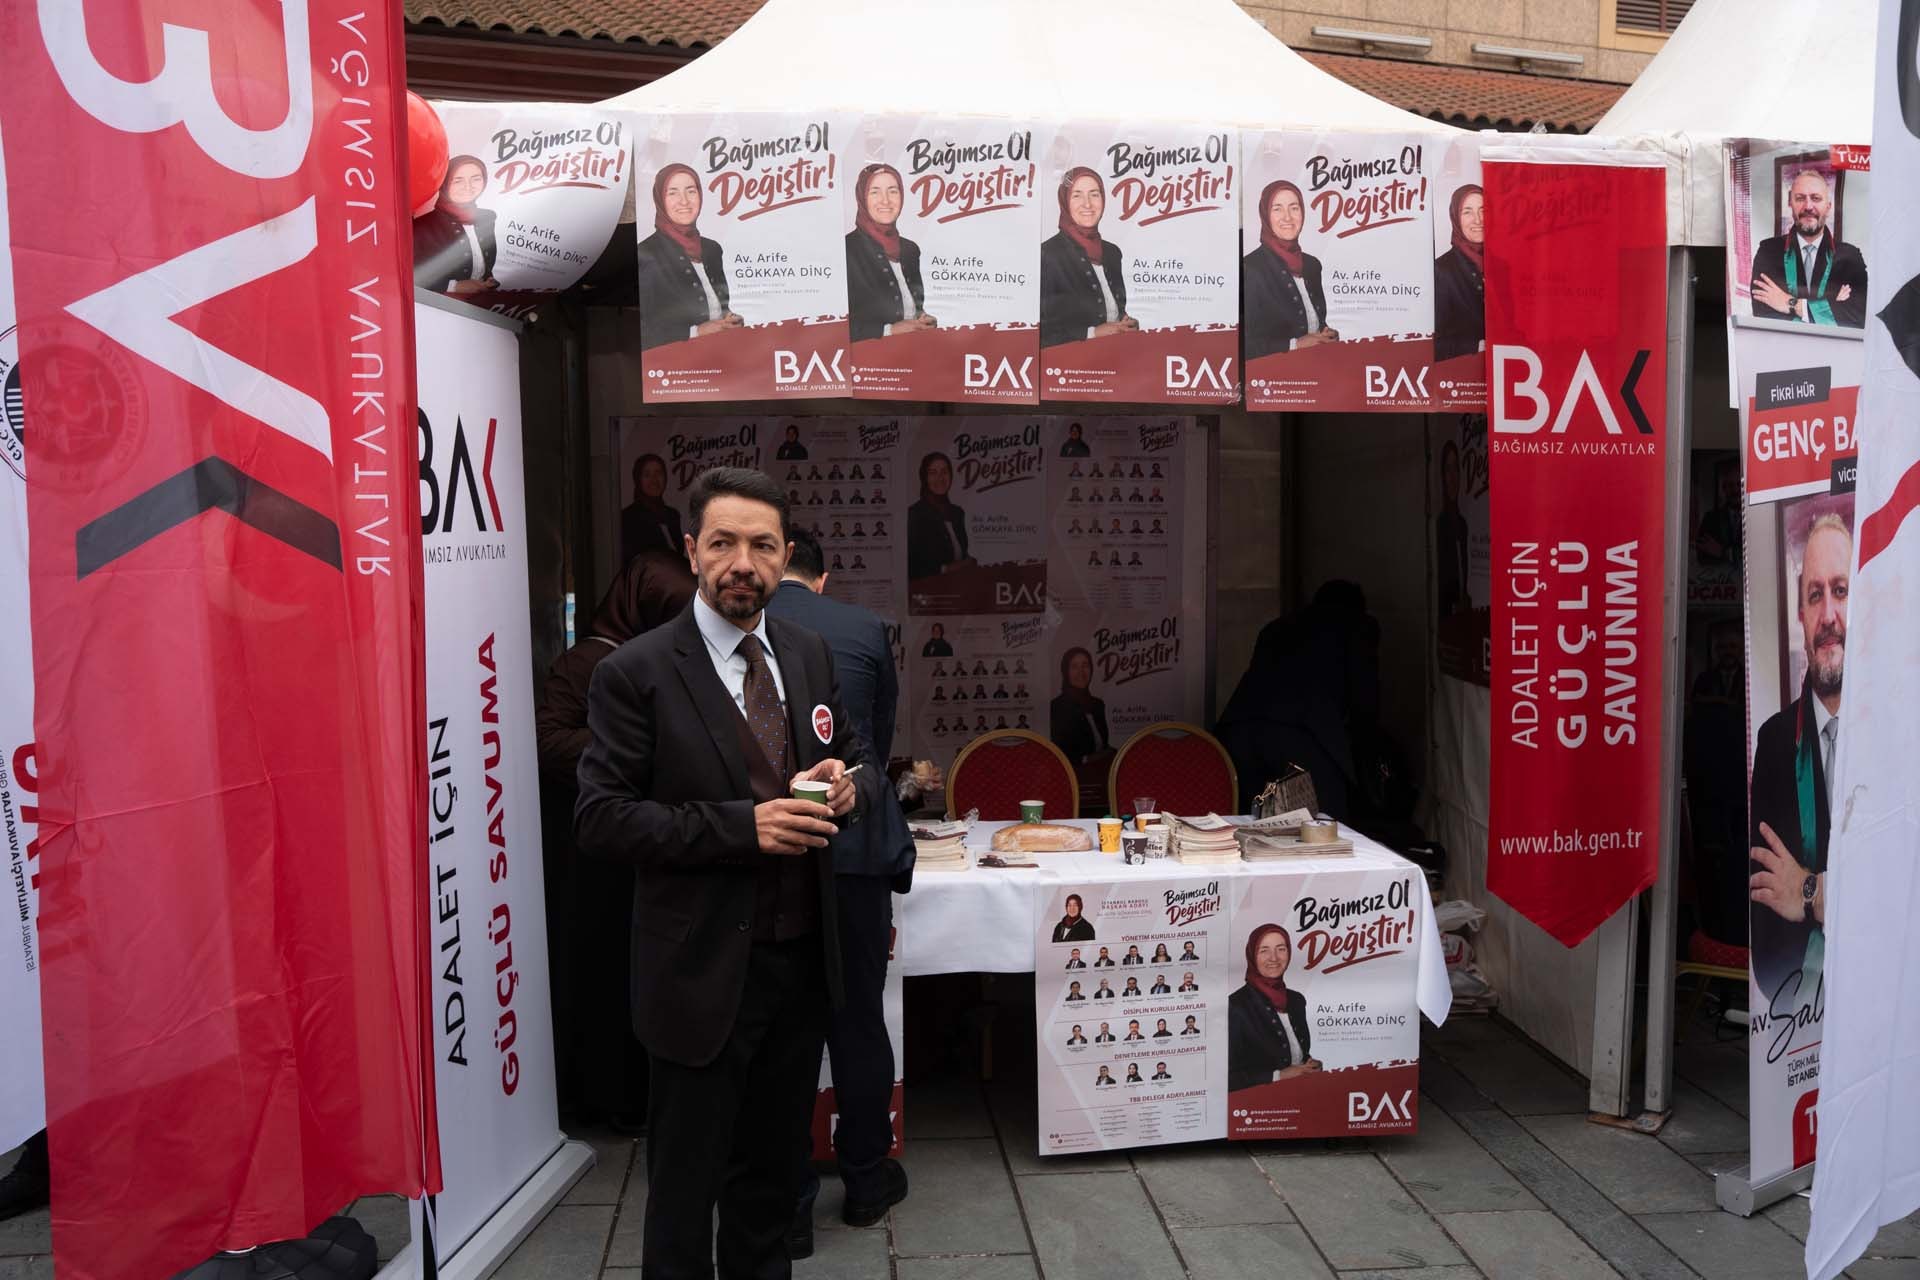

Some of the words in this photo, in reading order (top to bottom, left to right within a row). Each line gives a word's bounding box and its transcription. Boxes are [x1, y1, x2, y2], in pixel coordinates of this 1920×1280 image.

[491, 128, 593, 163] Bağımsız
[596, 120, 622, 147] Ol
[702, 136, 801, 173] Bağımsız
[804, 121, 829, 152] Ol
[906, 139, 1004, 175] Bağımsız
[1007, 131, 1032, 161] Ol
[1107, 142, 1202, 178] Bağımsız
[1205, 134, 1228, 163] Ol
[494, 147, 626, 192] Değiştir!
[708, 153, 836, 216] Değiştir!
[1305, 155, 1397, 191] Bağımsız
[1400, 144, 1422, 175] Ol
[910, 163, 1036, 218] Değiştir!
[1112, 165, 1233, 221] Değiştir!
[1311, 176, 1427, 233] Değiştir!
[506, 234, 561, 259] GÖKKAYA
[508, 220, 526, 233] Av.
[530, 225, 560, 242] Arife
[734, 253, 753, 263] Av.
[757, 252, 788, 263] Arife
[735, 266, 796, 278] GÖKKAYA
[800, 265, 832, 279] DİNÇ
[931, 255, 949, 266] Av.
[953, 256, 984, 267] Arife
[1133, 258, 1150, 268] Av.
[1154, 259, 1184, 270] Arife
[1332, 270, 1349, 280] Av.
[1353, 270, 1381, 280] Arife
[931, 269, 990, 282] GÖKKAYA
[995, 272, 1025, 286] DİNÇ
[1133, 271, 1190, 284] GÖKKAYA
[1194, 273, 1225, 287] DİNÇ
[1332, 283, 1388, 295] GÖKKAYA
[1392, 283, 1421, 297] DİNÇ
[774, 349, 846, 384] BAK
[964, 353, 1034, 389] BAK
[1166, 355, 1233, 390] BAK
[1365, 365, 1430, 398] BAK
[1492, 344, 1655, 435] BAK
[1771, 383, 1794, 402] FİKRİ
[1796, 381, 1815, 398] HÜR
[667, 434, 737, 461] Bağımsız
[954, 433, 1021, 459] Bağımsız
[1023, 424, 1040, 446] Ol
[1493, 437, 1564, 455] BAĞIMSIZ
[1571, 441, 1656, 456] AVUKATLAR
[1753, 418, 1826, 462] GENÇ
[957, 447, 1043, 490] Değiştir!
[1838, 467, 1857, 484] VİCD
[424, 546, 453, 563] IMSIZ
[456, 544, 507, 562] AVUKATLAR
[1507, 542, 1547, 608] İÇİN
[1093, 626, 1158, 654] Bağımsız
[1161, 617, 1176, 638] Ol
[1549, 541, 1597, 749] GÜÇLÜ
[1603, 540, 1639, 746] SAVUNMA
[1097, 638, 1180, 682] Değiştir!
[1511, 617, 1539, 749] ADALET
[478, 631, 508, 884] SAVUMA
[429, 716, 458, 843] İÇİN
[1500, 829, 1643, 857] www.bak.gen.tr
[1163, 887, 1207, 907] Bağımsız
[1207, 880, 1219, 896] Ol
[1166, 895, 1221, 926] Değiştir!
[1293, 894, 1385, 933] Bağımsız
[1387, 878, 1410, 909] Ol
[1298, 909, 1415, 970] Değiştir!
[438, 863, 467, 1066] ADALET
[488, 903, 519, 1097] GÜÇLÜ
[1316, 1004, 1334, 1013] Av.
[1337, 1002, 1366, 1013] Arife
[1751, 1013, 1771, 1036] AV.
[1767, 969, 1825, 1064] Sal
[1316, 1016, 1372, 1027] GÖKKAYA
[1376, 1013, 1406, 1026] DİNÇ
[1787, 1058, 1805, 1074] TÜRK
[1805, 1055, 1820, 1068] MİLL
[1787, 1066, 1820, 1087] İSTANBU
[1348, 1089, 1413, 1122] BAK
